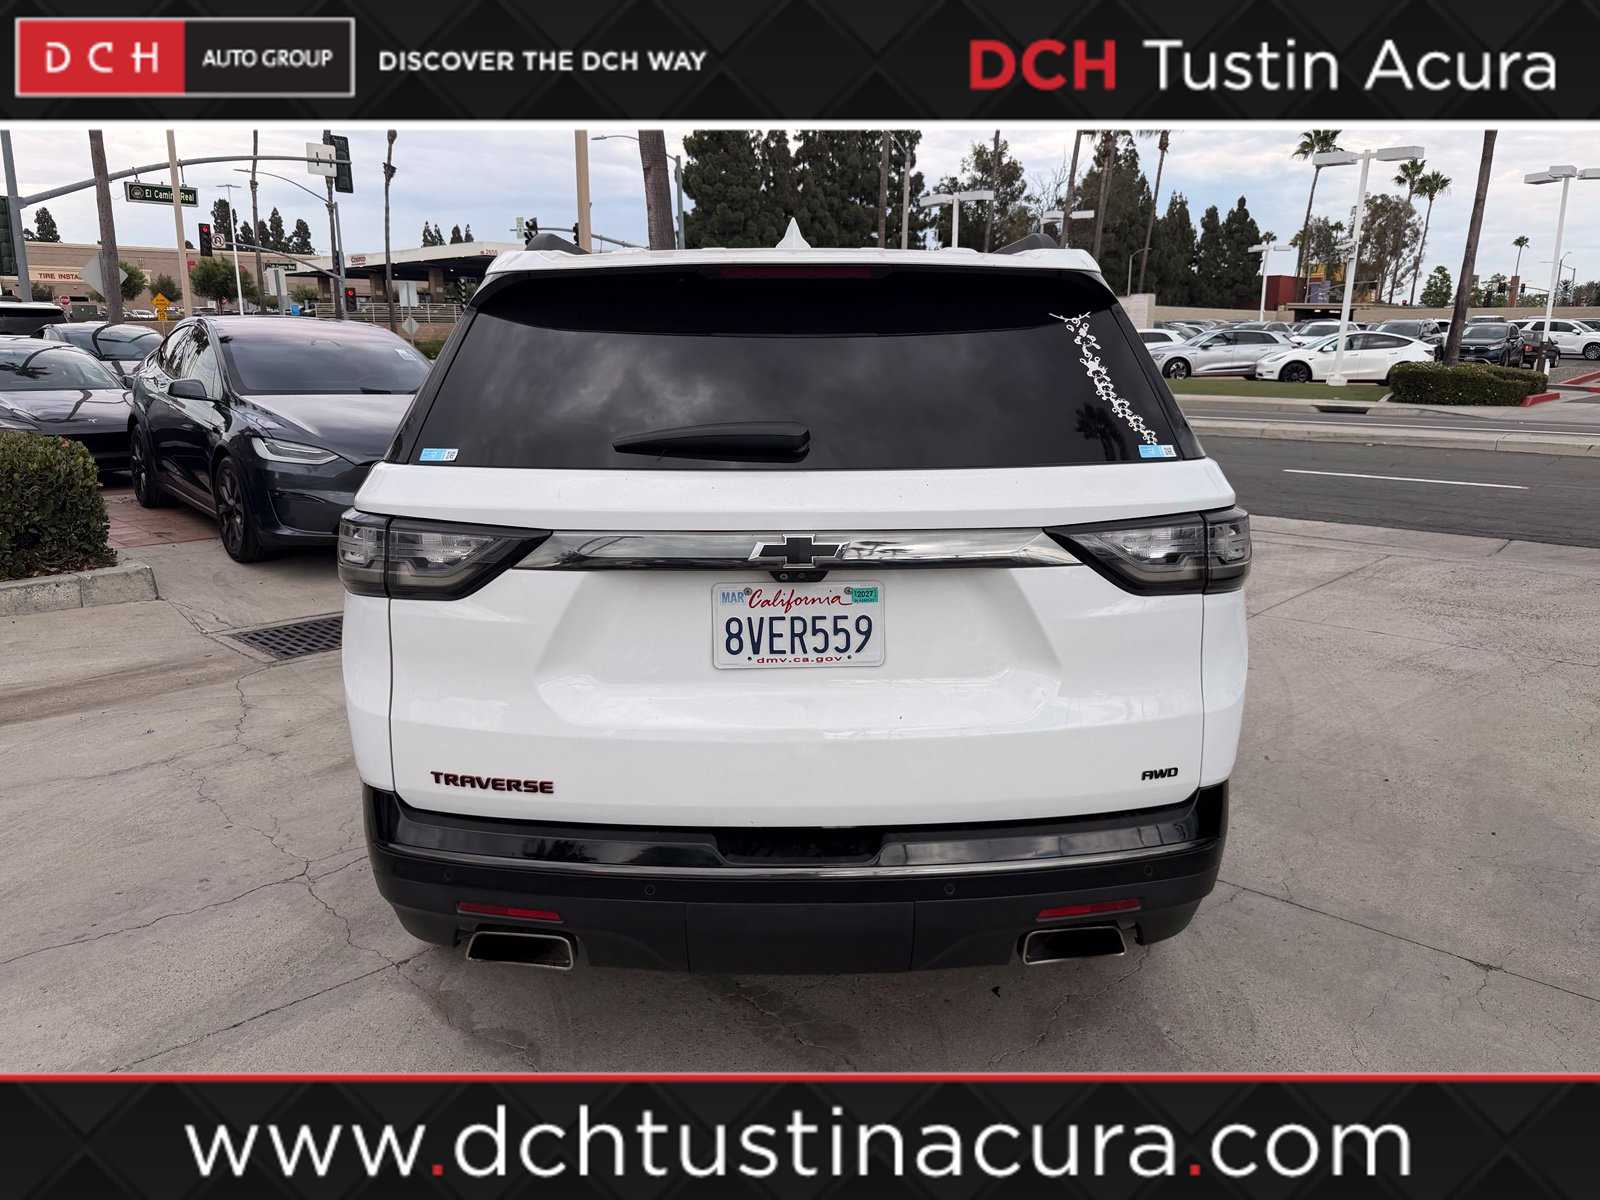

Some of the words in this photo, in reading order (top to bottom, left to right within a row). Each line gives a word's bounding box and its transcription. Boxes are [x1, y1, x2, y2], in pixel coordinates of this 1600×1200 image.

[145, 189, 152, 198] El
[154, 190, 174, 200] Camin
[180, 192, 195, 202] Real
[38, 272, 56, 280] TIRE
[721, 591, 745, 603] MAR
[748, 588, 852, 614] California
[725, 615, 873, 655] 8VER559
[756, 655, 843, 664] dmv.ca.gov
[1141, 767, 1178, 781] AWD
[430, 771, 554, 793] TRAVERSE
